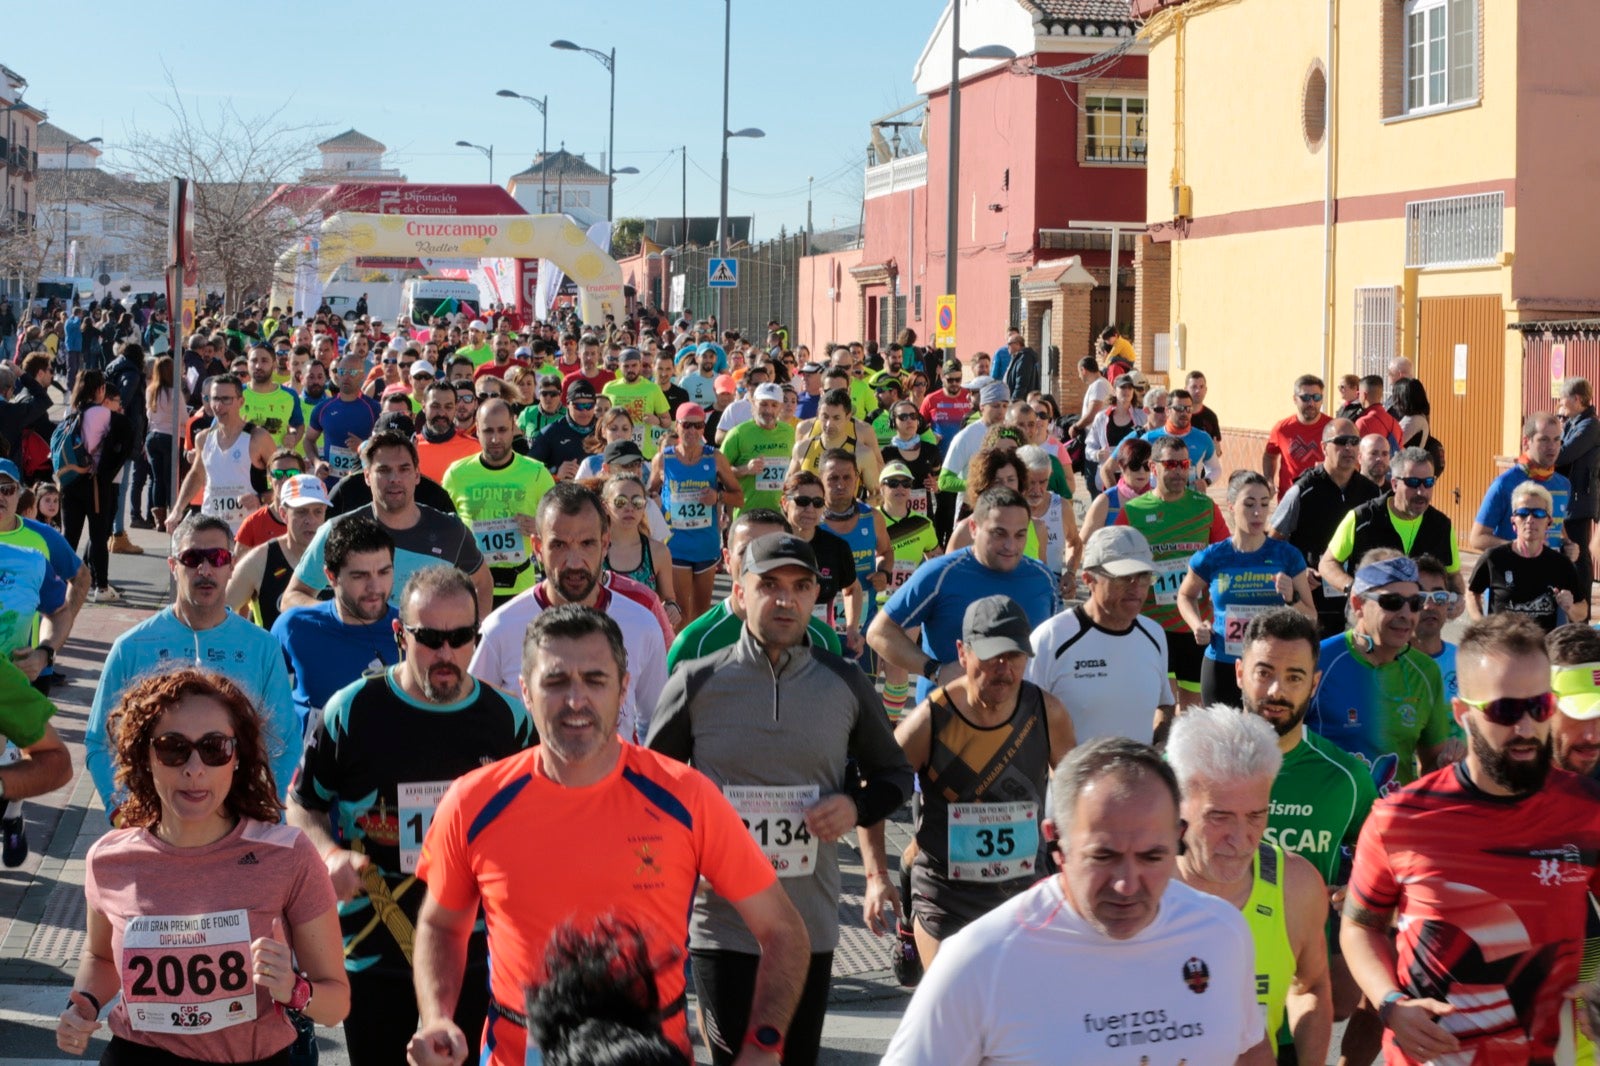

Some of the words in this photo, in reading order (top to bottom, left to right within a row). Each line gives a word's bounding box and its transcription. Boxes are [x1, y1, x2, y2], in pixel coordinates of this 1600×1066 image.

[404, 191, 457, 203] Diputación
[403, 203, 415, 214] de
[416, 204, 458, 214] Granada
[406, 221, 498, 239] Cruzcampo
[415, 241, 459, 253] Radler
[762, 467, 786, 480] 237
[678, 503, 706, 517] 432
[481, 532, 516, 551] 105
[1234, 571, 1274, 583] olimp
[741, 817, 811, 847] 134
[975, 827, 1016, 858] 35
[150, 920, 169, 932] GRAN
[170, 918, 199, 932] PREMIO
[200, 917, 211, 930] DE
[213, 914, 240, 928] FONDO
[128, 950, 248, 997] 2068
[1083, 1009, 1168, 1034] fuerzas
[1106, 1021, 1206, 1049] armadas
